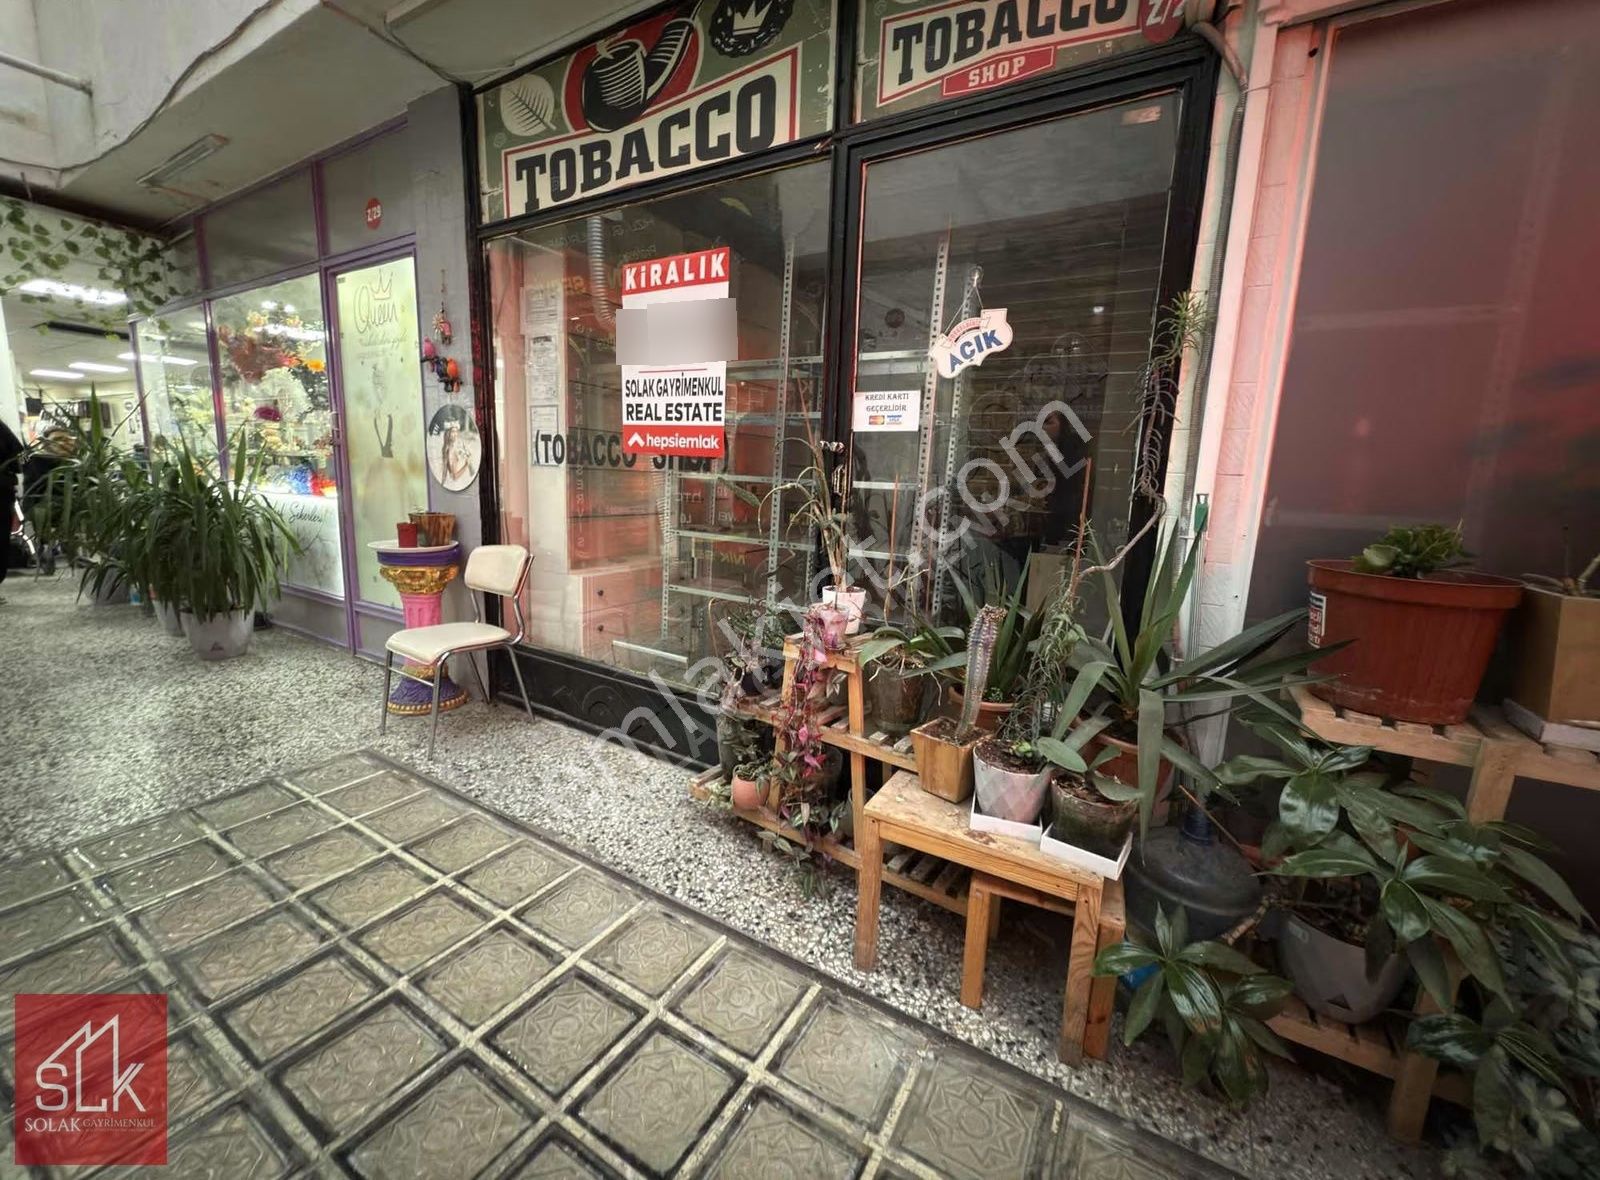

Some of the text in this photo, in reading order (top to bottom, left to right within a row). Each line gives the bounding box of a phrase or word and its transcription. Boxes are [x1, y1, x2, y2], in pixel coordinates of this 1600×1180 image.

[968, 55, 1026, 88] SHOP
[515, 75, 777, 216] TOBACCO
[625, 372, 723, 398] SOLAK GAYRİMENKUL
[626, 402, 722, 421] REAL ESTATE
[646, 433, 719, 451] hepsiemlak
